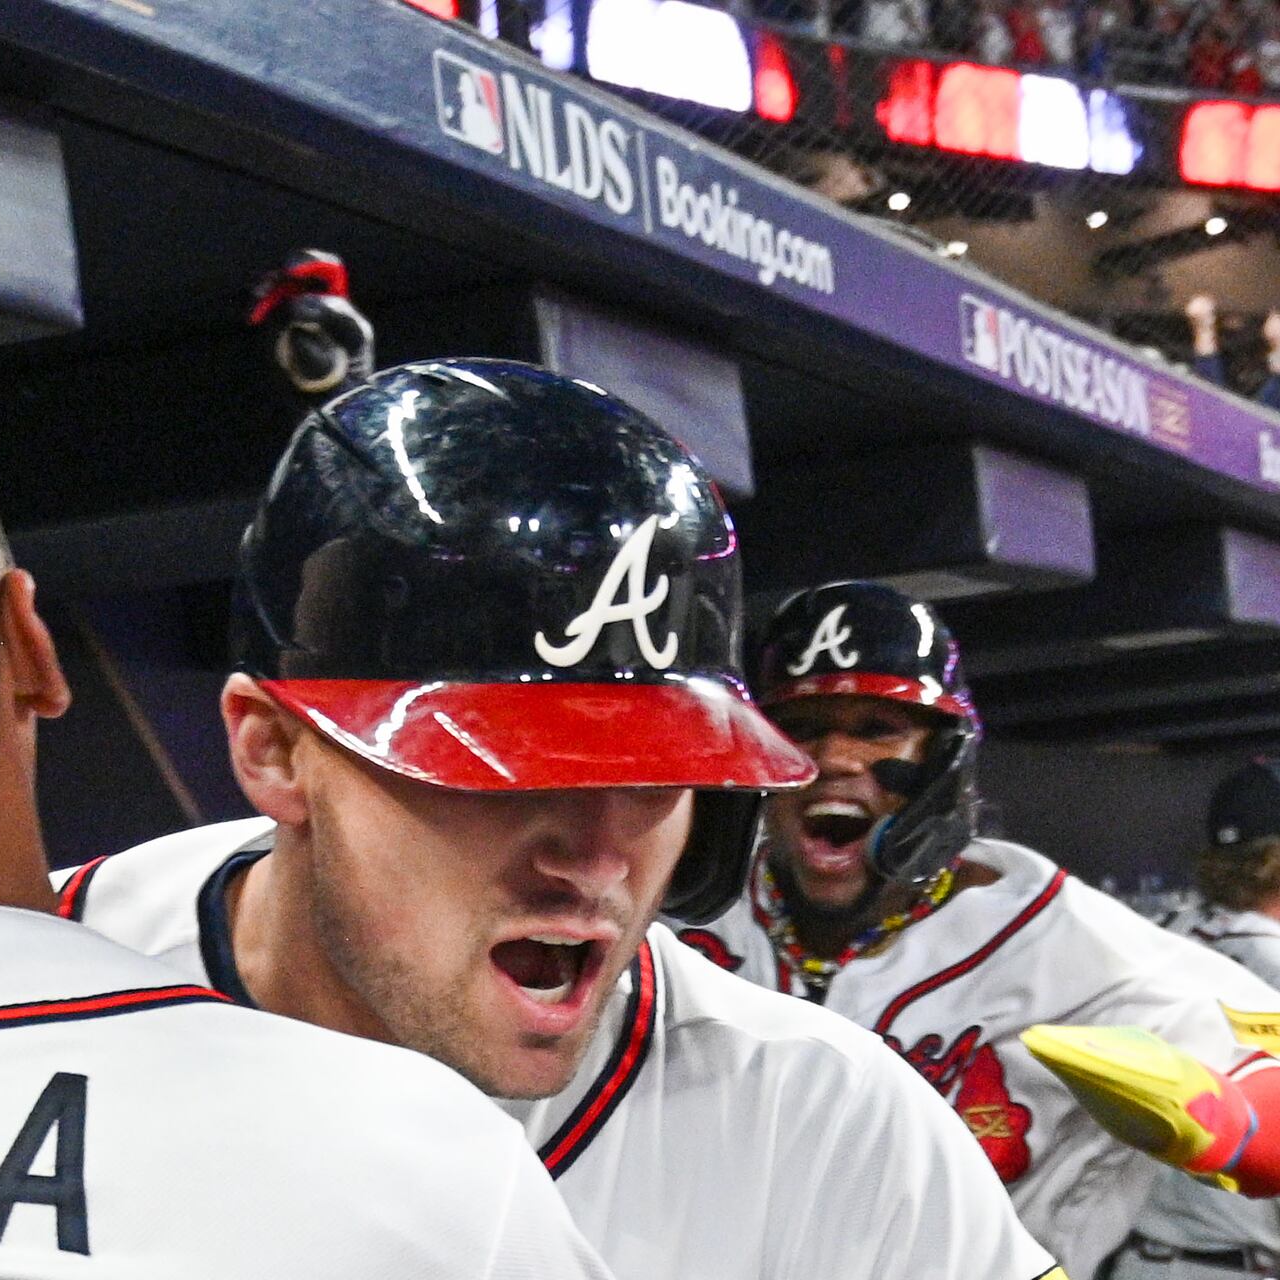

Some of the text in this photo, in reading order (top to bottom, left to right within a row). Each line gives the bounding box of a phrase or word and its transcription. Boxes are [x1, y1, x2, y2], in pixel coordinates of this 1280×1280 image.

[502, 72, 834, 294] NLDS Booking.com
[998, 308, 1151, 436] POSTSEASON
